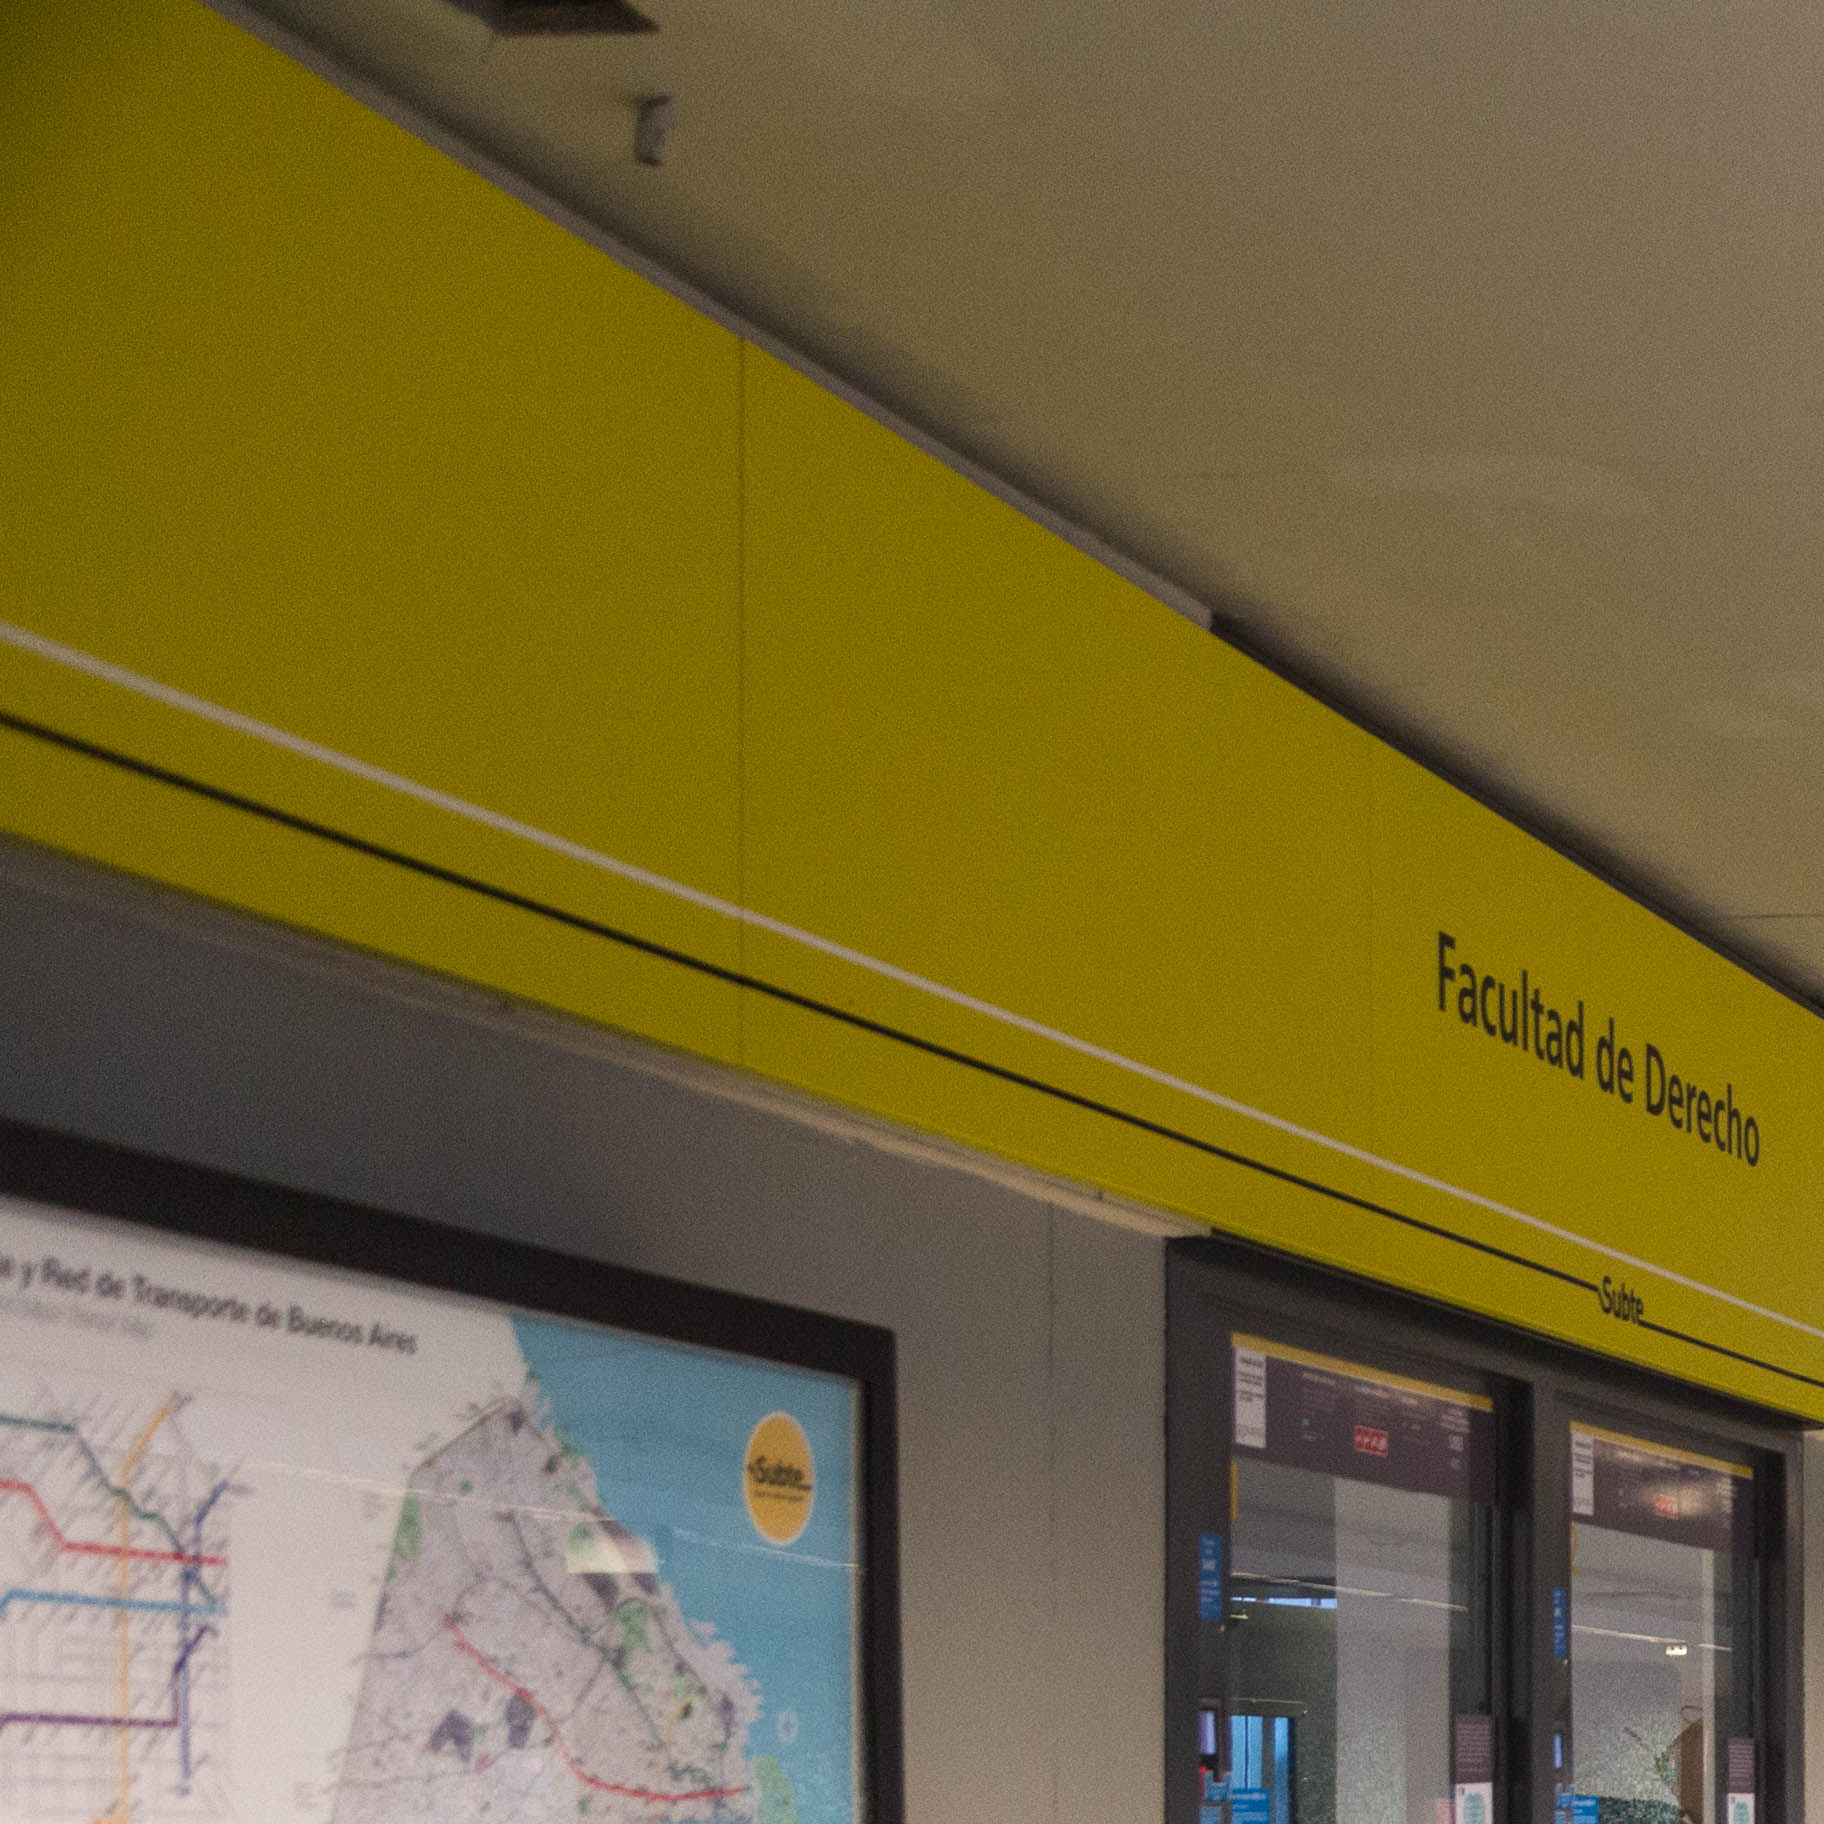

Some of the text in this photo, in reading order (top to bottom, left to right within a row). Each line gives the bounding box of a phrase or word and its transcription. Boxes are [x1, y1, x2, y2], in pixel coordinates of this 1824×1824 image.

[1437, 930, 1761, 1168] Facultad de Derecho
[95, 1270, 125, 1299] de
[130, 1272, 250, 1321] Transporte
[254, 1301, 281, 1330] de
[286, 1304, 364, 1345] Buenos
[368, 1319, 419, 1355] Aires
[1598, 1275, 1644, 1326] Subte
